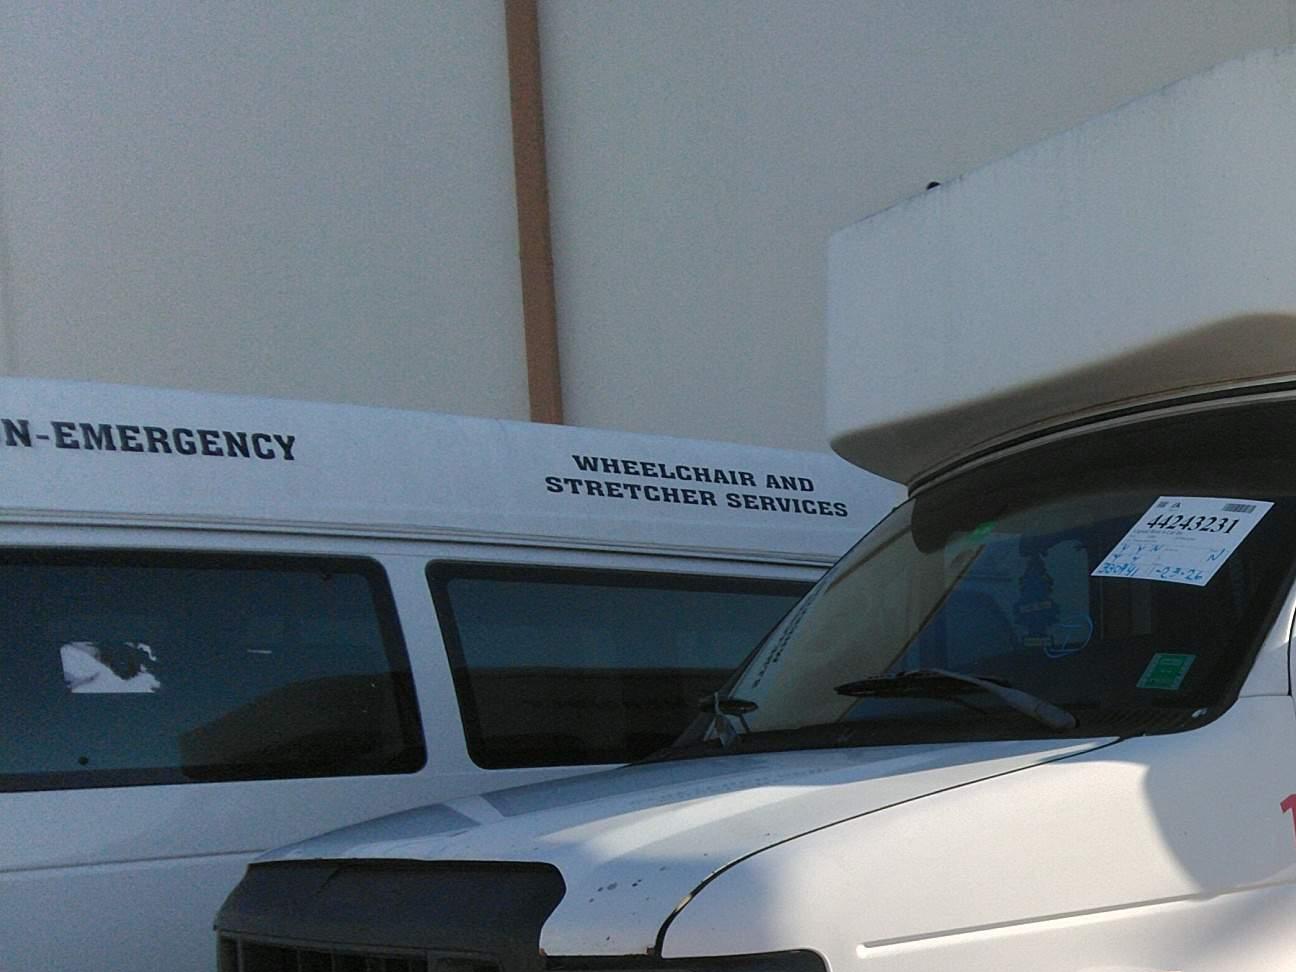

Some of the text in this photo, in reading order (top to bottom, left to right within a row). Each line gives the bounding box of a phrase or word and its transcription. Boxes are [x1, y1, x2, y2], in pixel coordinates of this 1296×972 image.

[571, 454, 815, 493] WHEELCHAIR AND
[545, 476, 849, 518] STRETCHER SERVICES
[1147, 514, 1240, 534] 44243231
